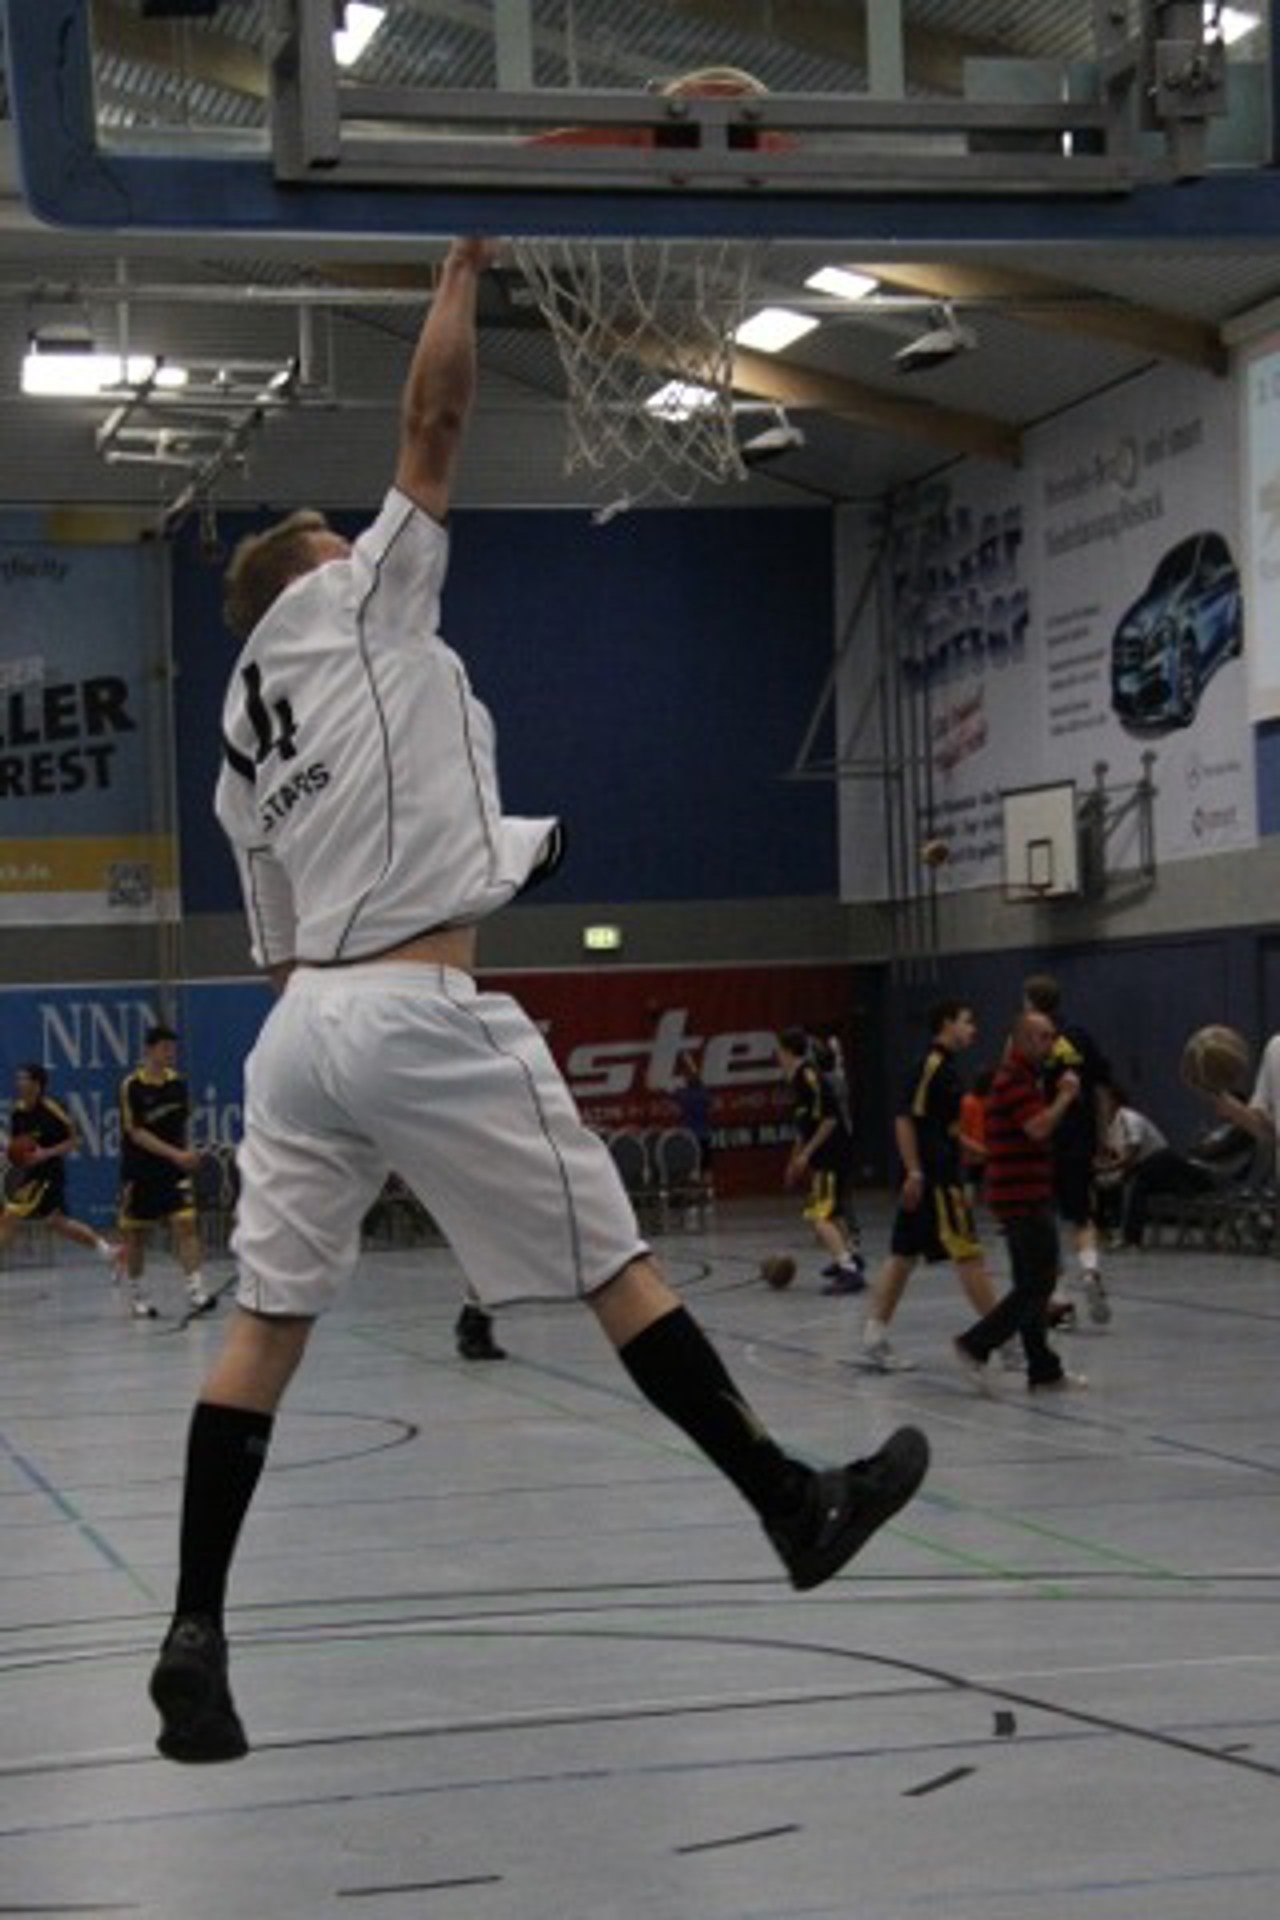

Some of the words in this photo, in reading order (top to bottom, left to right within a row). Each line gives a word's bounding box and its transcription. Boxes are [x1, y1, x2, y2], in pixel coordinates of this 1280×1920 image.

[0, 675, 136, 750] LER
[0, 743, 116, 797] REST
[565, 1008, 790, 1098] ste
